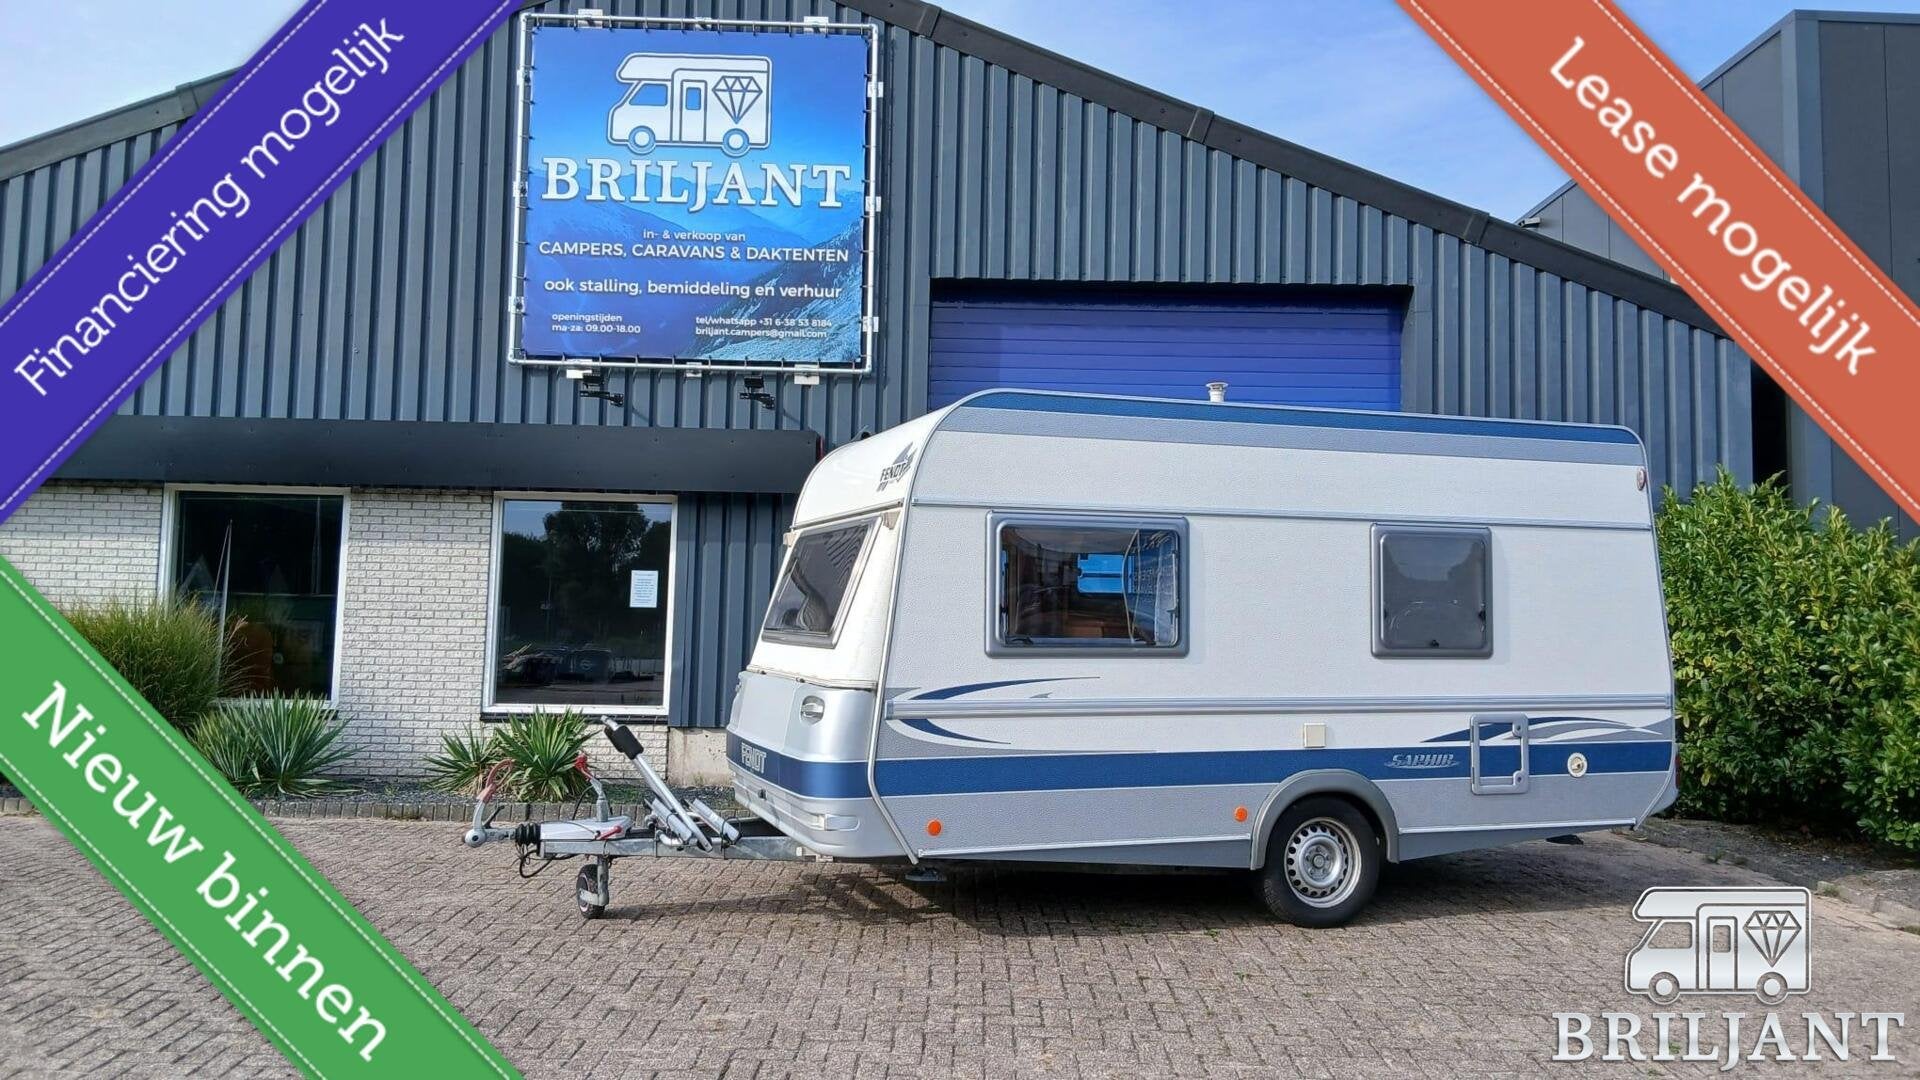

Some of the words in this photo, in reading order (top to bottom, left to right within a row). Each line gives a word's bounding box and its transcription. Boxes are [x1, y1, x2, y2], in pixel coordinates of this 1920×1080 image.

[541, 157, 850, 212] BRILJANT
[643, 228, 658, 239] in-
[662, 229, 671, 239] &
[674, 230, 721, 243] verkoop
[725, 232, 746, 241] van
[539, 241, 627, 257] CAMPERS,
[632, 244, 725, 258] CARAVANS
[730, 246, 741, 260] &
[746, 246, 849, 262] DAKTENTEN
[544, 278, 575, 291] ook
[579, 279, 642, 295] stalling,
[647, 280, 750, 298] bemiddeling
[755, 285, 775, 297] en
[779, 284, 842, 298] verhuur
[552, 313, 622, 323] openingstijden
[759, 317, 773, 326] +31
[585, 324, 641, 334] 09.00-18.00
[695, 327, 827, 338] briljant.campers@gmail.com
[741, 742, 767, 774] FENDT
[1392, 753, 1454, 768] SAPHIR
